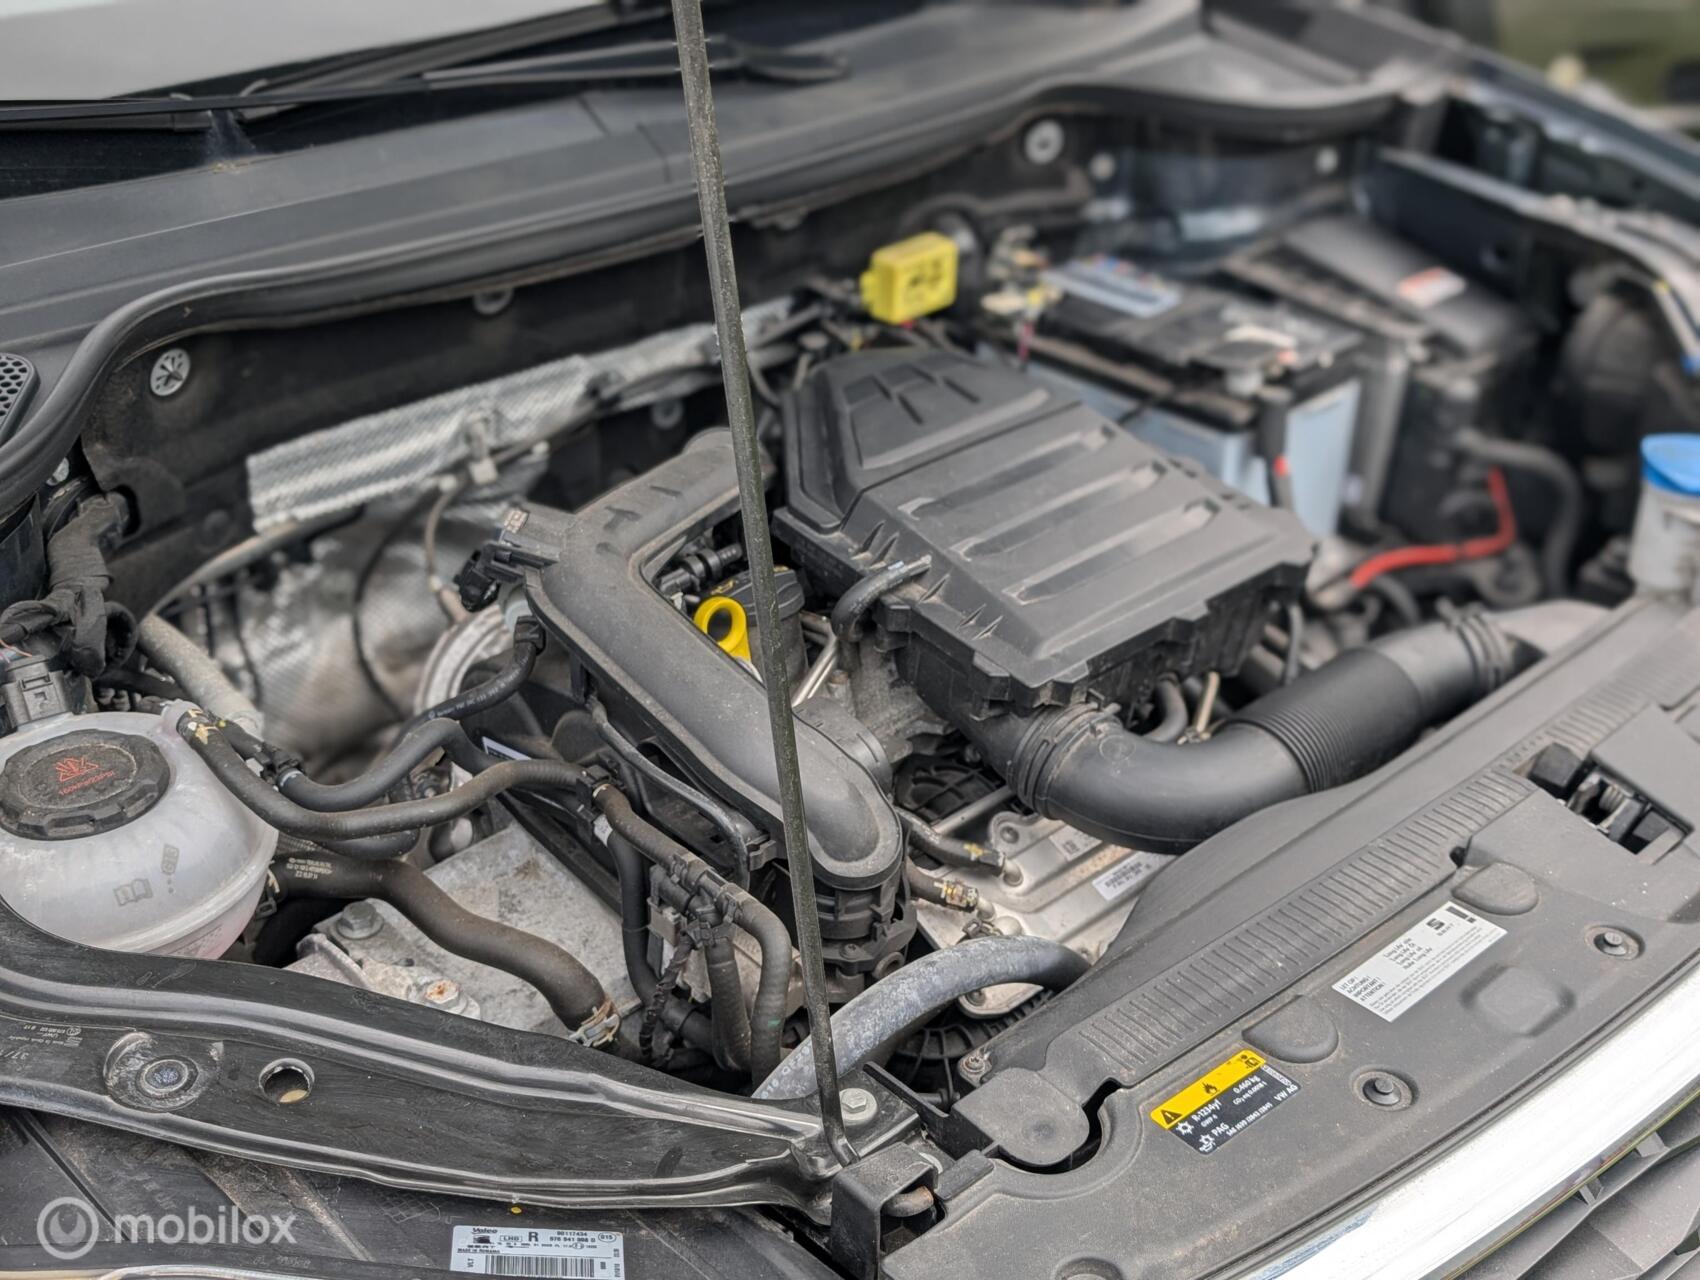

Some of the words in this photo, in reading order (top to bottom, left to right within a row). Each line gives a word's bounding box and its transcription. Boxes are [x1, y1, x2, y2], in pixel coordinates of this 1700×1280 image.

[1274, 1089, 1288, 1102] VW
[1285, 1083, 1299, 1095] AG
[1211, 1122, 1230, 1137] PAG
[528, 1231, 539, 1242] R
